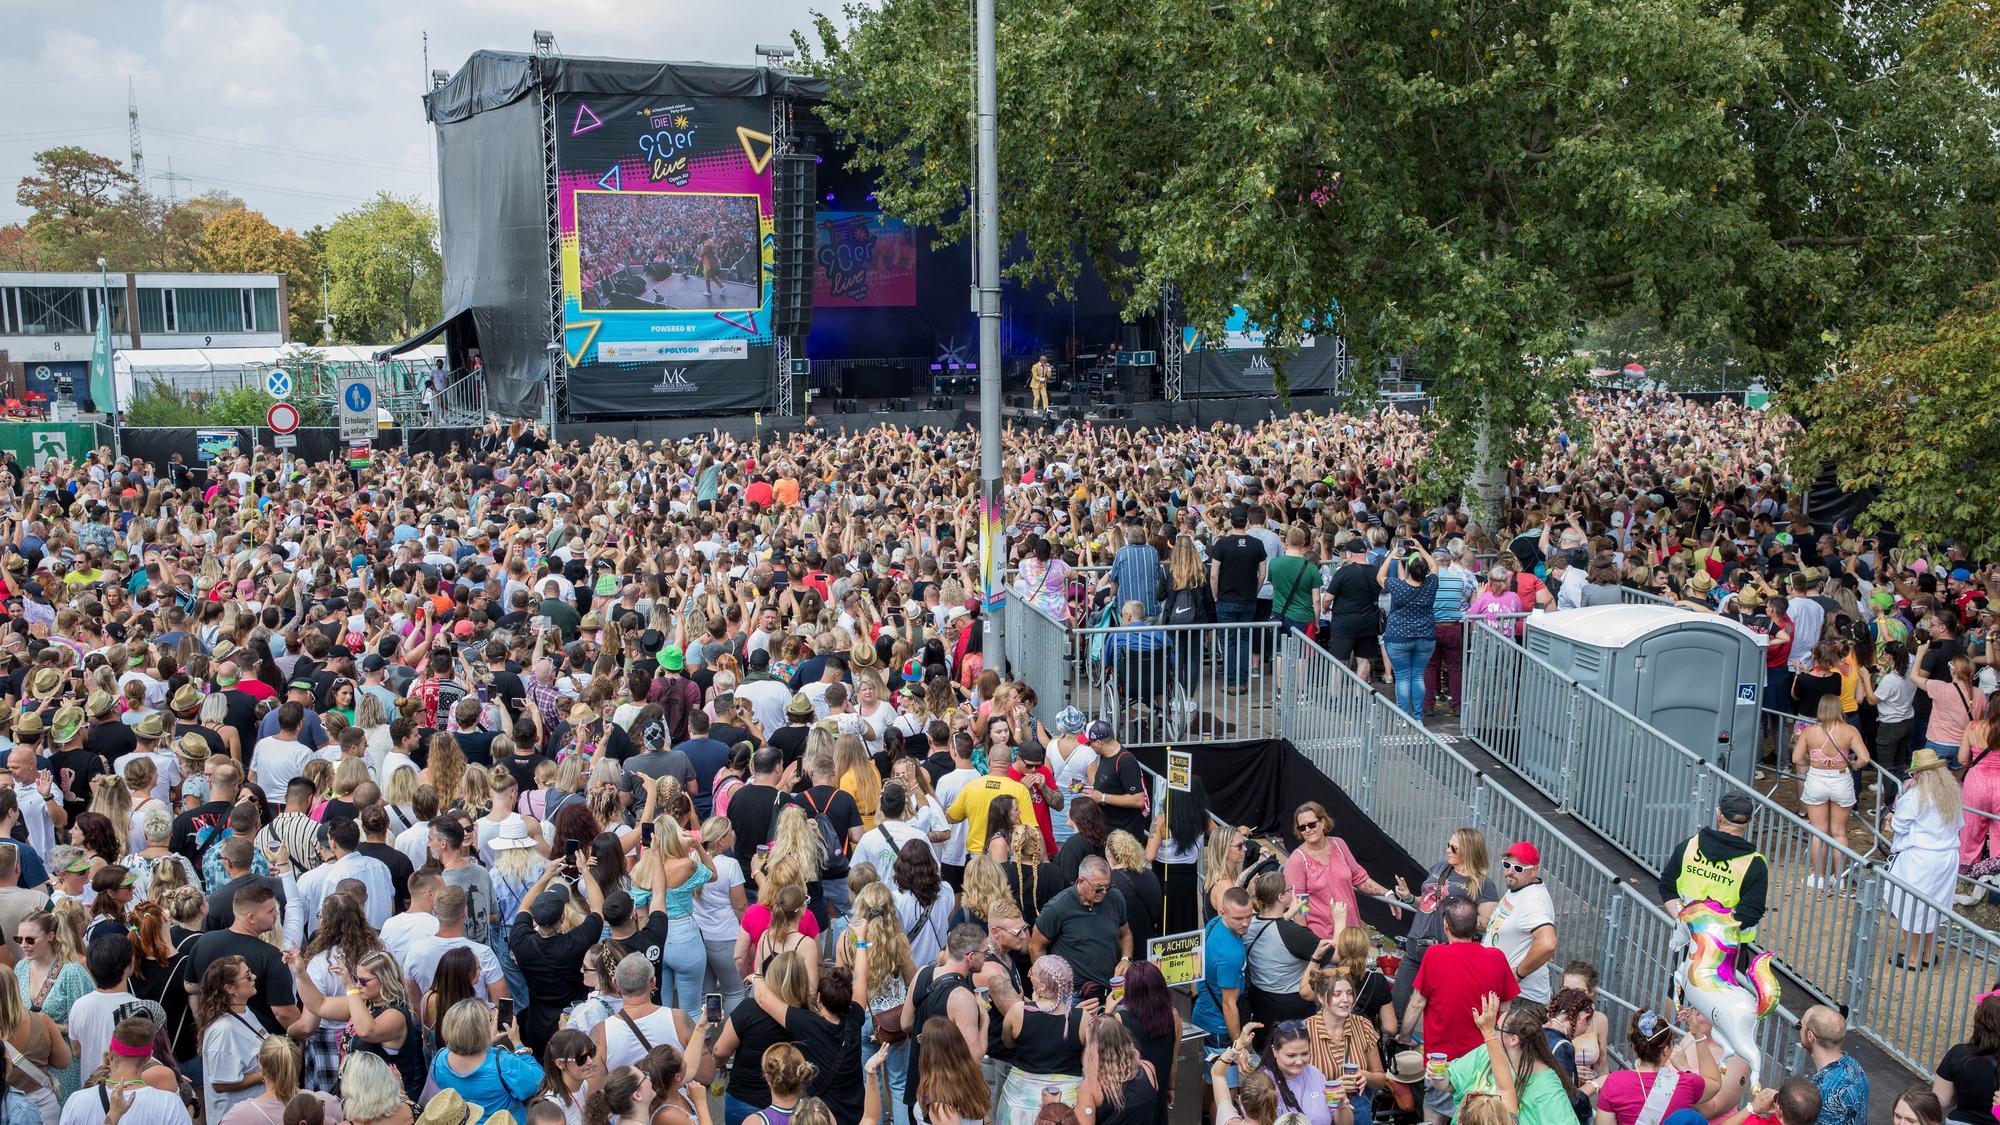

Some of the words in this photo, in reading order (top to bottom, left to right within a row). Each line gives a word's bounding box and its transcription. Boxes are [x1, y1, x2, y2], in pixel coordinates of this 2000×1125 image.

[654, 117, 669, 128] DIE
[639, 130, 695, 162] 90er
[652, 156, 687, 180] live
[668, 175, 682, 183] Open
[835, 230, 848, 241] DIE
[821, 242, 874, 276] 90er
[832, 270, 865, 294] live
[651, 325, 685, 333] POWERED
[54, 341, 61, 351] 8
[205, 336, 212, 346] 9
[664, 346, 699, 354] POLYGON
[1250, 354, 1269, 369] MK
[662, 367, 688, 384] MK
[344, 416, 374, 425] Erholungs-
[350, 426, 368, 435] anlage
[1173, 773, 1185, 784] BIER
[1686, 864, 1735, 886] SECURITY
[1166, 936, 1200, 951] ACHTUNG
[649, 948, 659, 958] JD
[1169, 960, 1185, 968] Bier
